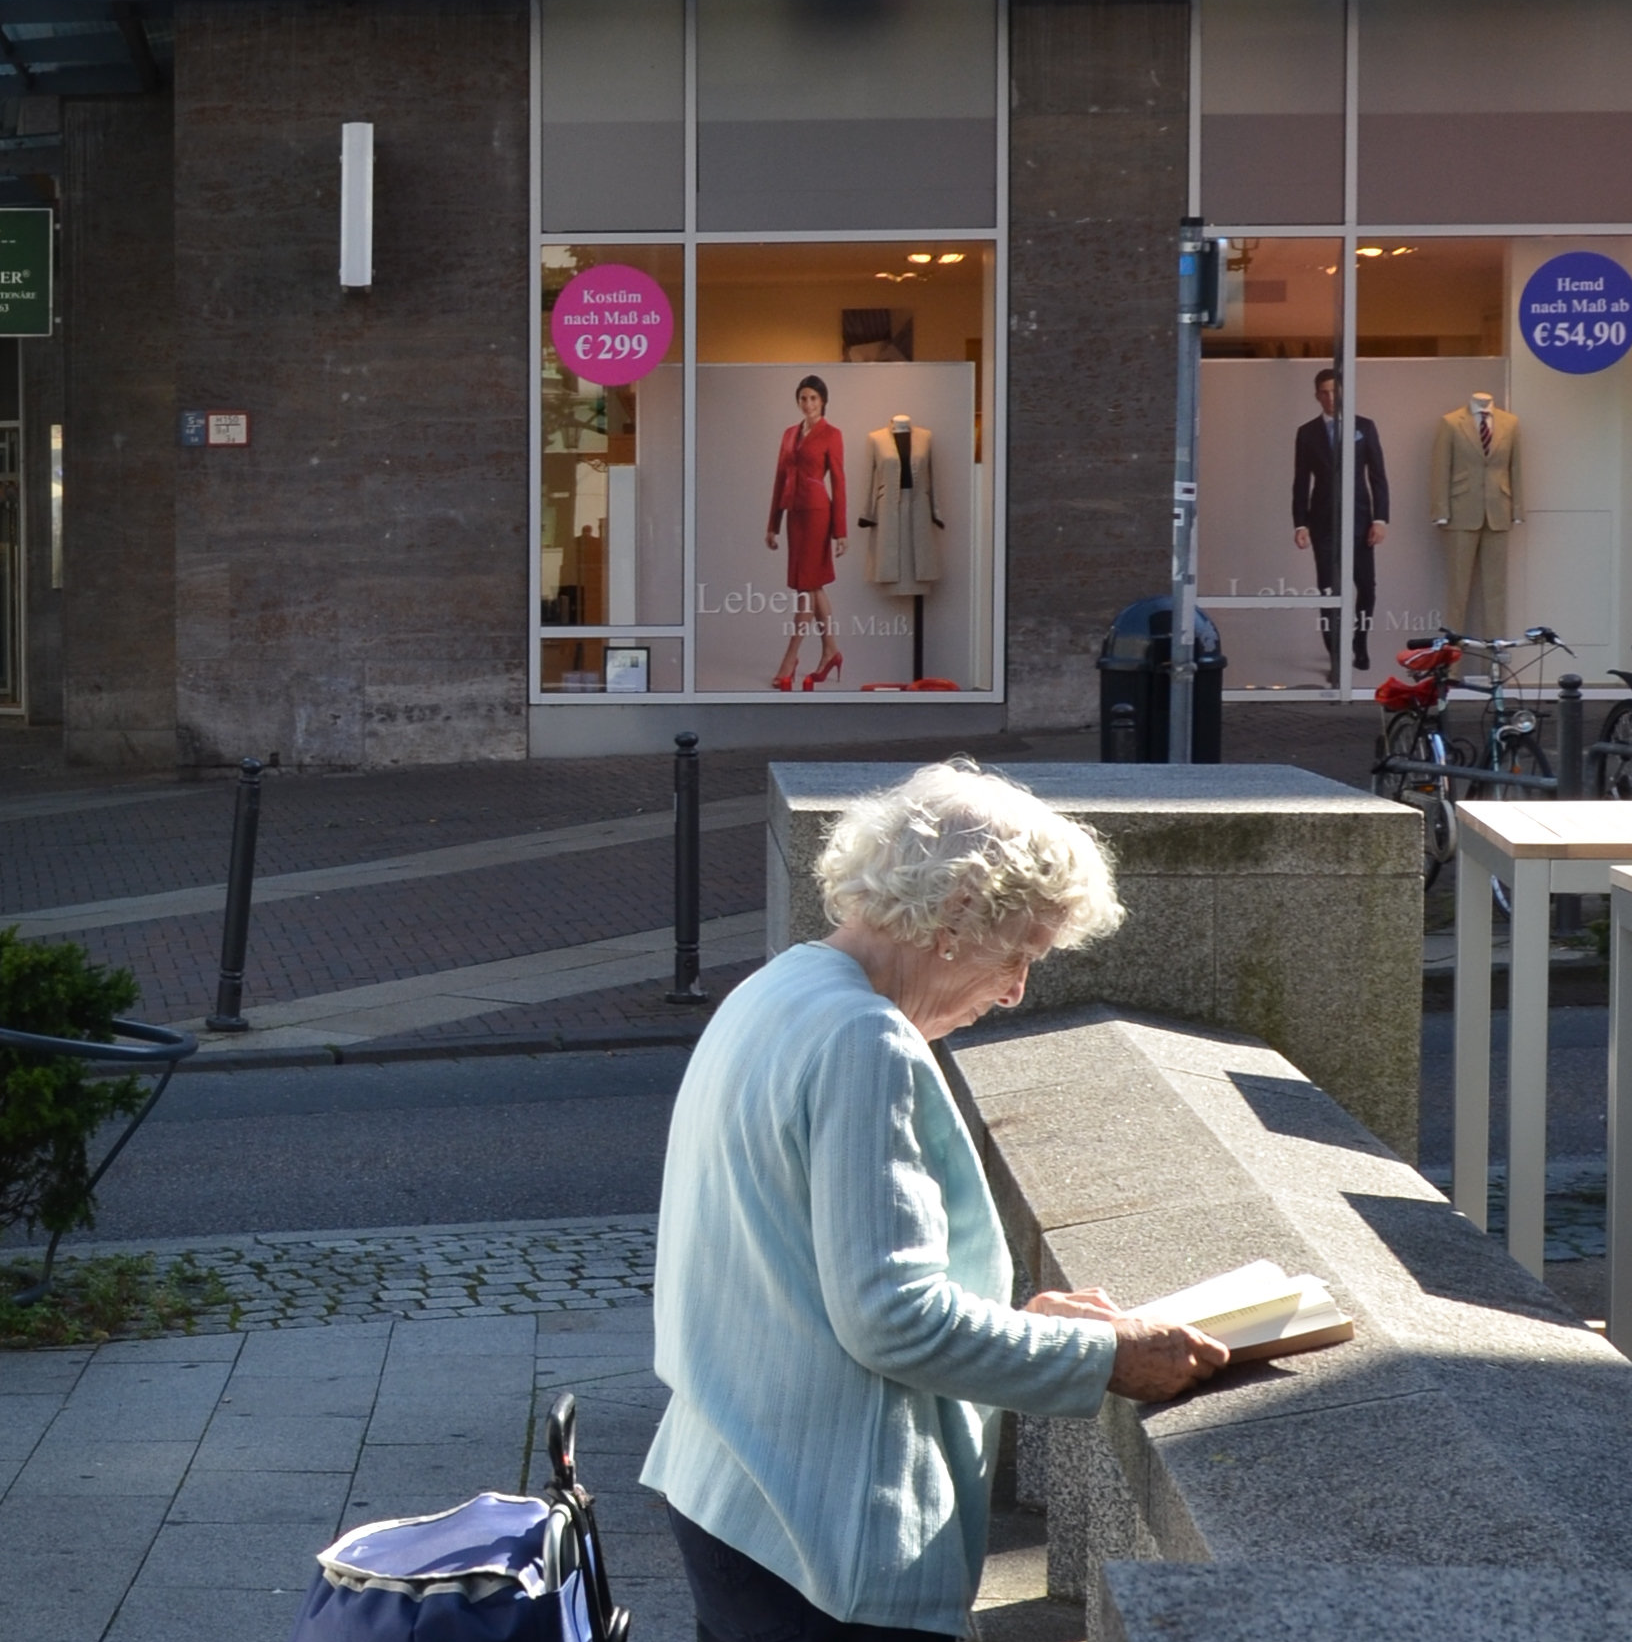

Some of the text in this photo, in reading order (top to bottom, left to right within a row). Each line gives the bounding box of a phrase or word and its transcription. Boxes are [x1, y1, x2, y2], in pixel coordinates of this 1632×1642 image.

[1556, 277, 1604, 292] Hemd
[582, 290, 642, 304] Kostüm
[1531, 298, 1630, 314] nach Maß ab
[563, 310, 661, 325] nach Maß ab
[696, 582, 814, 615] Leben
[783, 614, 841, 637] nach
[1316, 609, 1374, 632] nch
